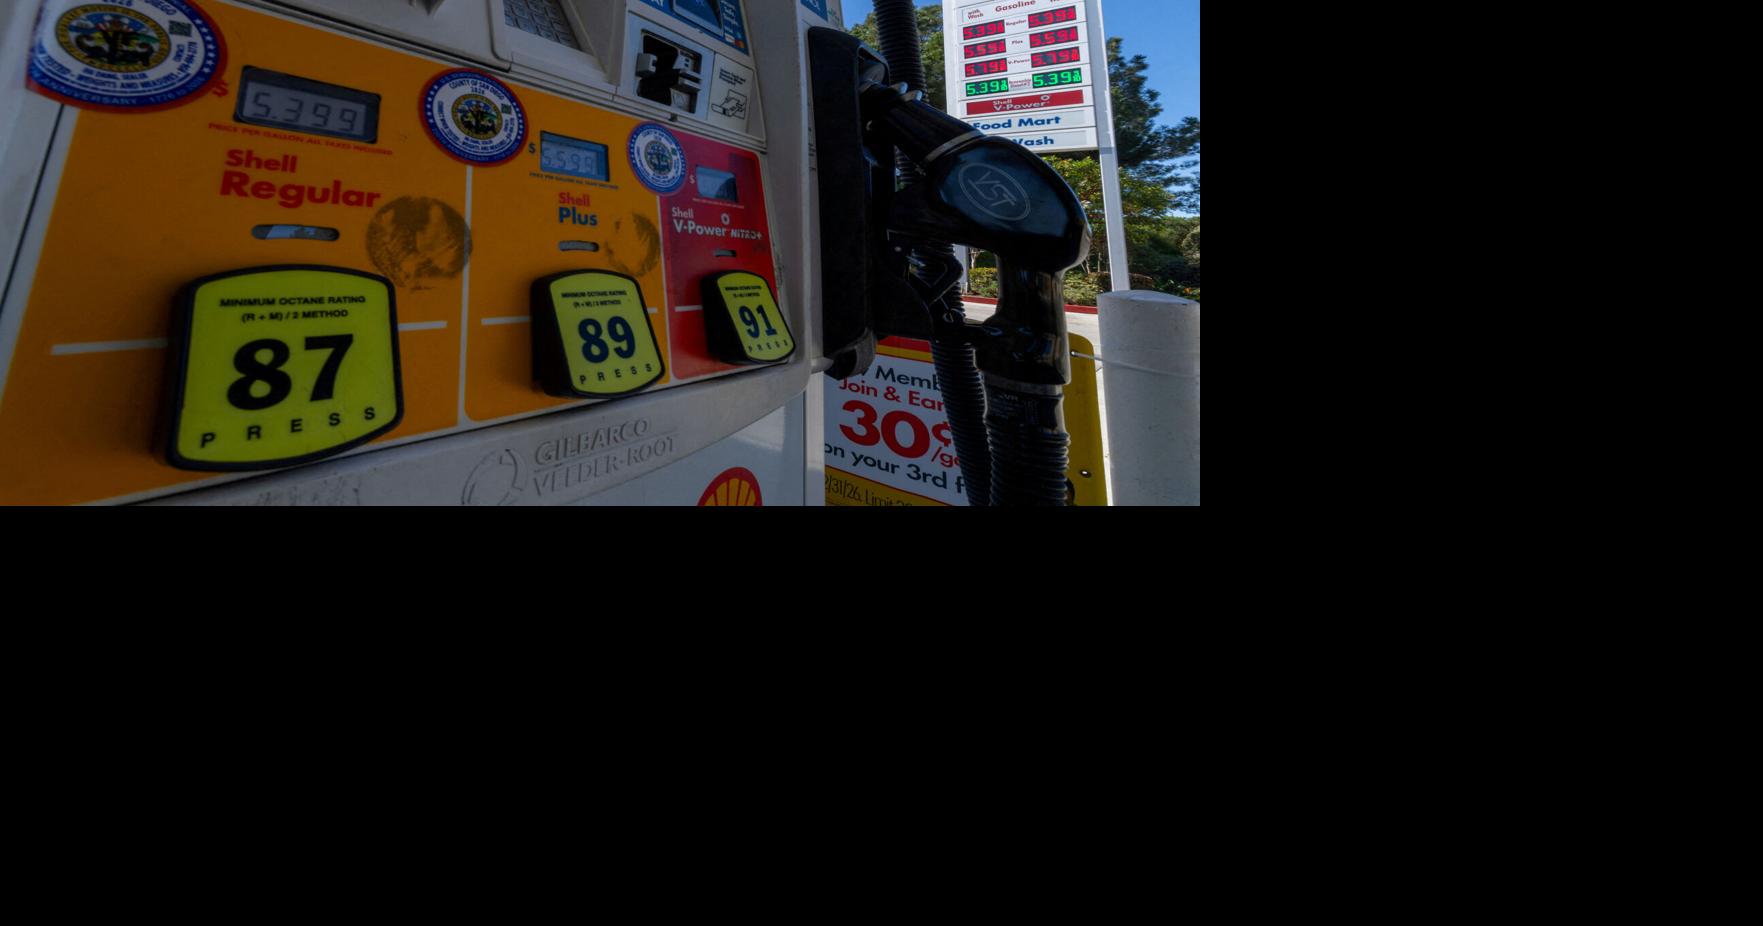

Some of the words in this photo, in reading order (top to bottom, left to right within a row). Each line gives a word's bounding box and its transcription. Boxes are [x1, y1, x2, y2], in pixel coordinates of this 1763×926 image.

[995, 0, 1036, 12] Gasoline
[252, 91, 357, 132] 5.399
[973, 120, 1012, 130] Food
[1018, 116, 1061, 128] Mart
[208, 122, 238, 134] PRICE
[241, 128, 261, 137] PER
[263, 131, 304, 143] GALLON
[306, 137, 321, 146] ALL
[225, 148, 298, 173] Shell
[220, 170, 381, 209] Regular
[558, 190, 591, 207] Shell
[968, 170, 1017, 207] VST
[558, 206, 598, 226] Plus
[672, 206, 694, 219] Shell
[672, 219, 727, 237] V-Power
[220, 297, 276, 307] MINIMUM
[278, 296, 325, 306] OCTANE
[328, 296, 366, 304] RATING
[292, 311, 299, 320] 2
[302, 309, 348, 320] METHOD
[738, 304, 778, 339] 91
[578, 316, 636, 364] 89
[227, 333, 354, 412] 87
[580, 363, 652, 385] PRESS
[839, 376, 878, 398] Join
[884, 386, 902, 403] &
[200, 406, 376, 448] PRESS
[840, 400, 953, 459] 30¢
[536, 418, 648, 466] GILBARCO
[533, 435, 674, 497] VEEDER-ROOT
[824, 442, 845, 458] on
[851, 450, 900, 476] your
[907, 463, 948, 490] 3rd
